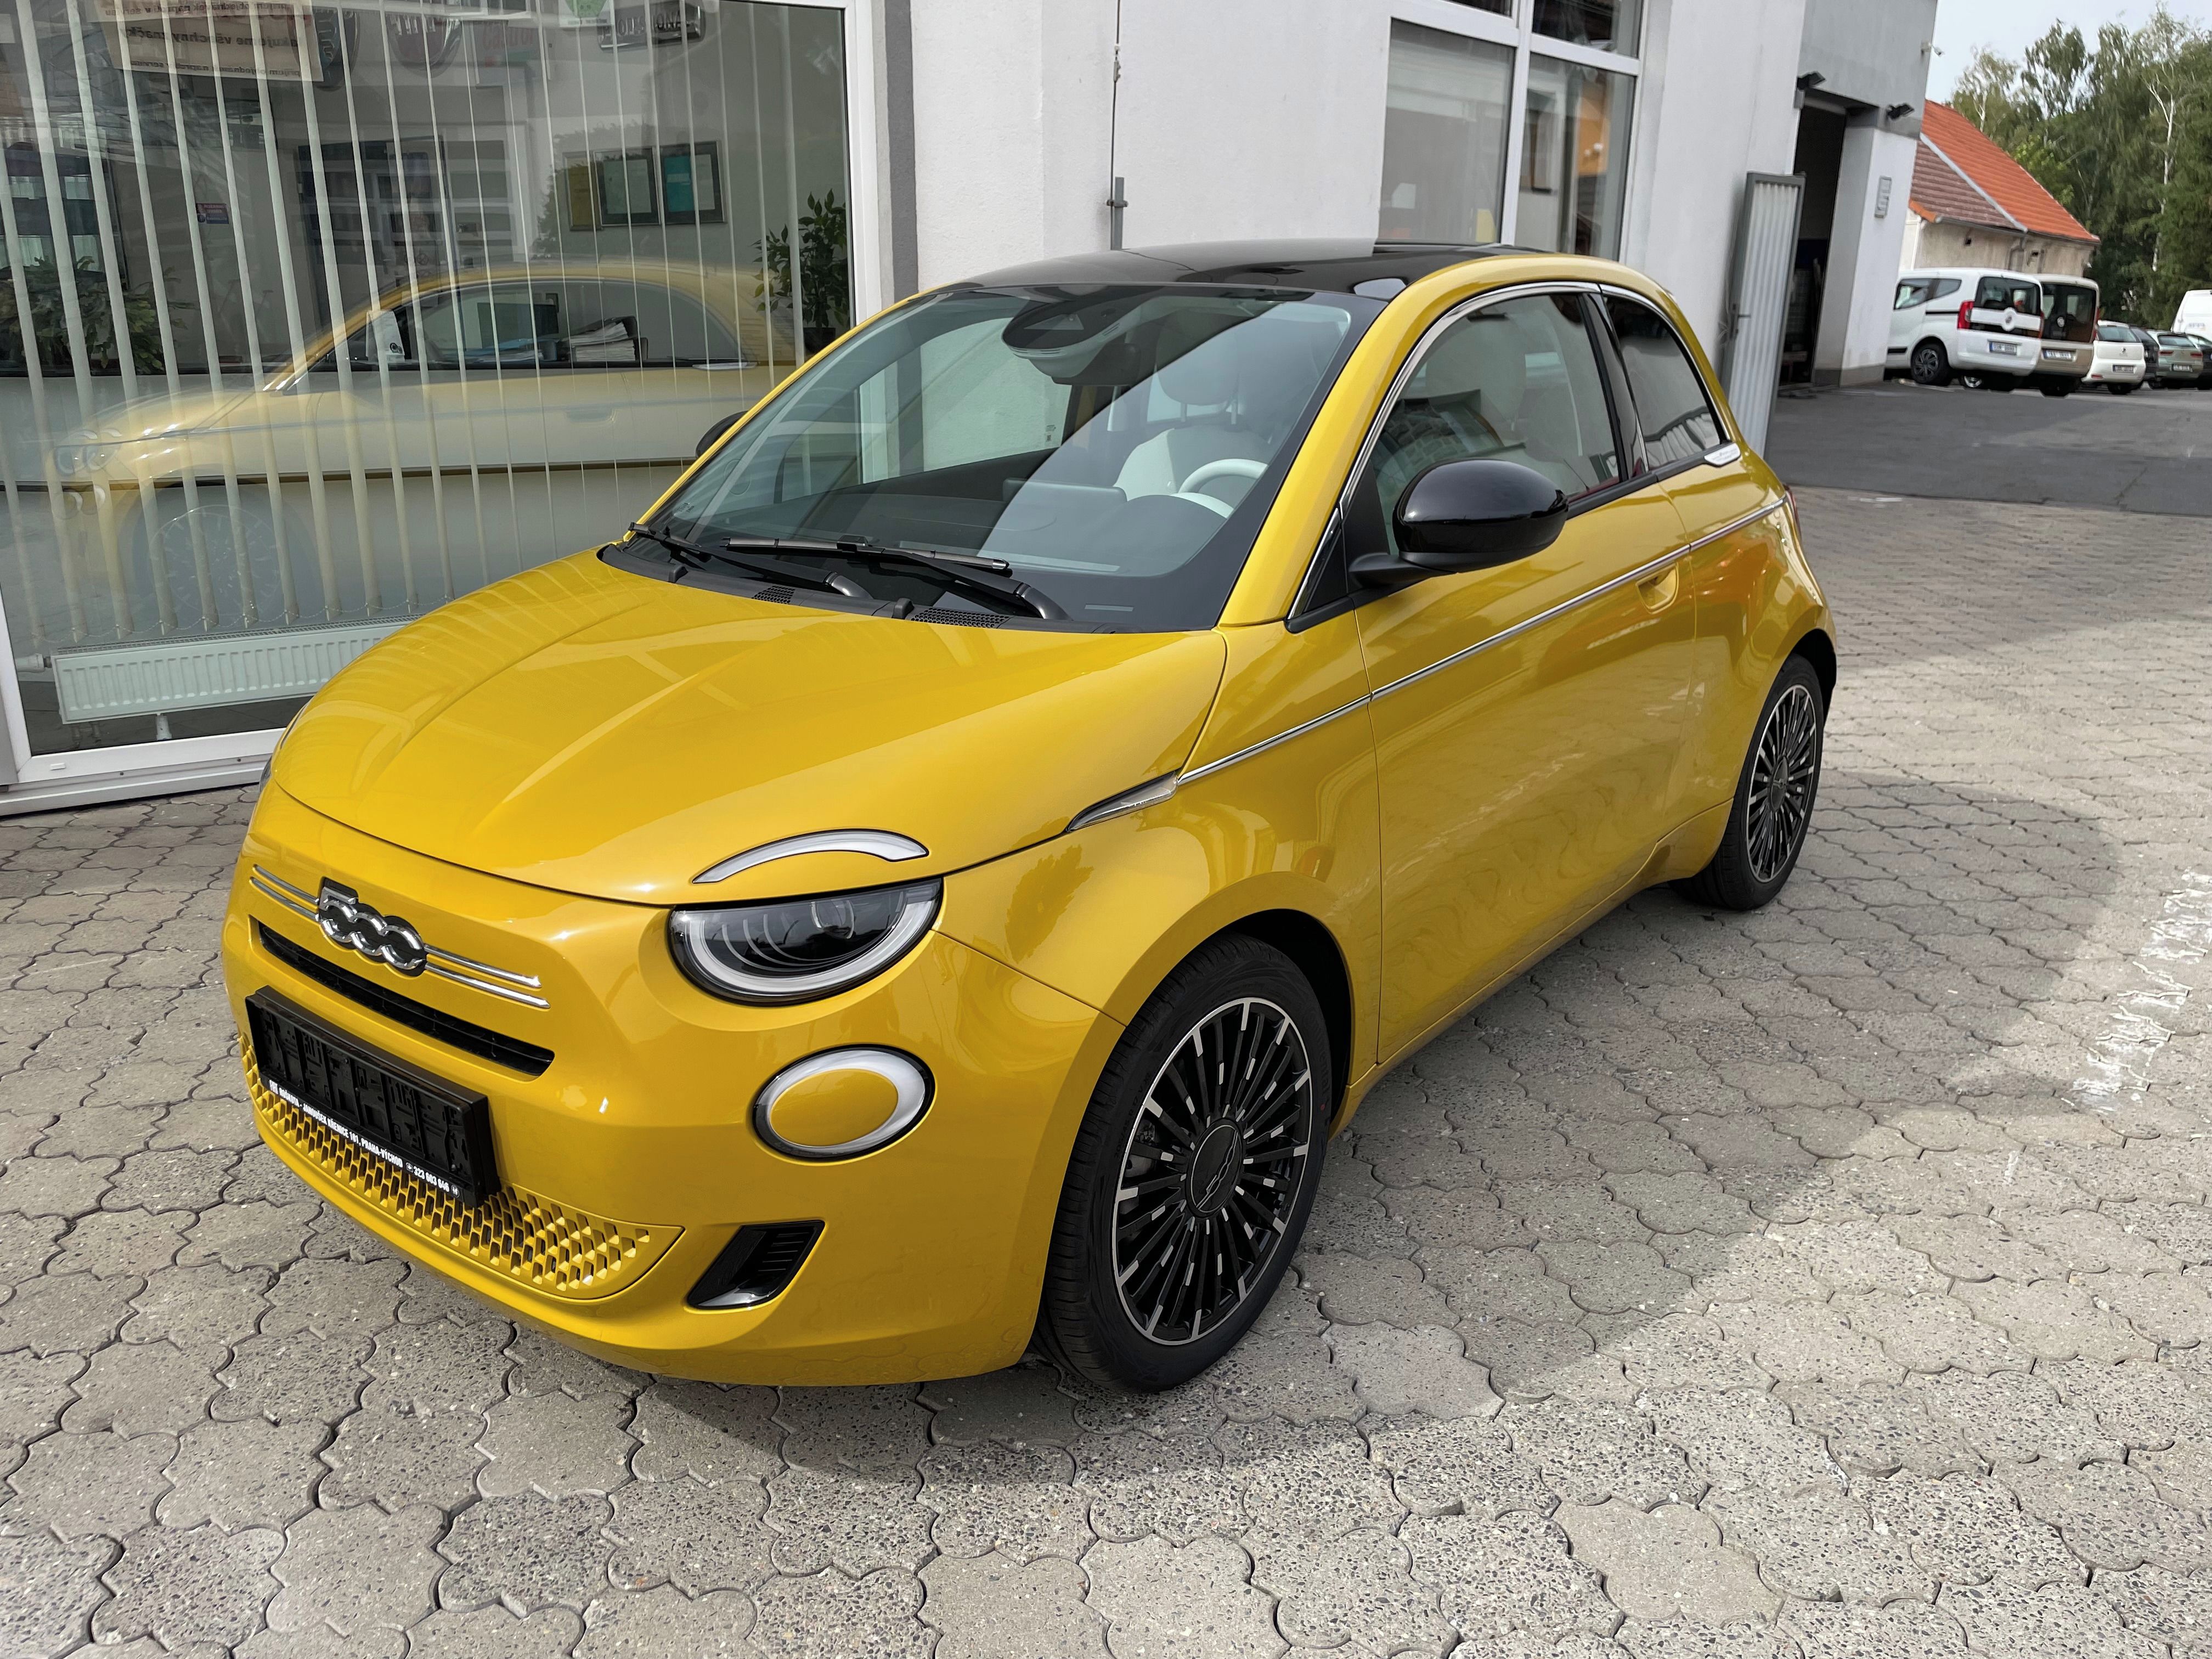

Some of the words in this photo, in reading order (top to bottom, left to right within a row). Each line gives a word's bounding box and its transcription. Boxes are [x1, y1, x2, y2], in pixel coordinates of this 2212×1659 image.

[319, 887, 425, 970] 500
[413, 1166, 425, 1180] 323
[425, 1172, 437, 1186] 603
[438, 1178, 450, 1192] 646
